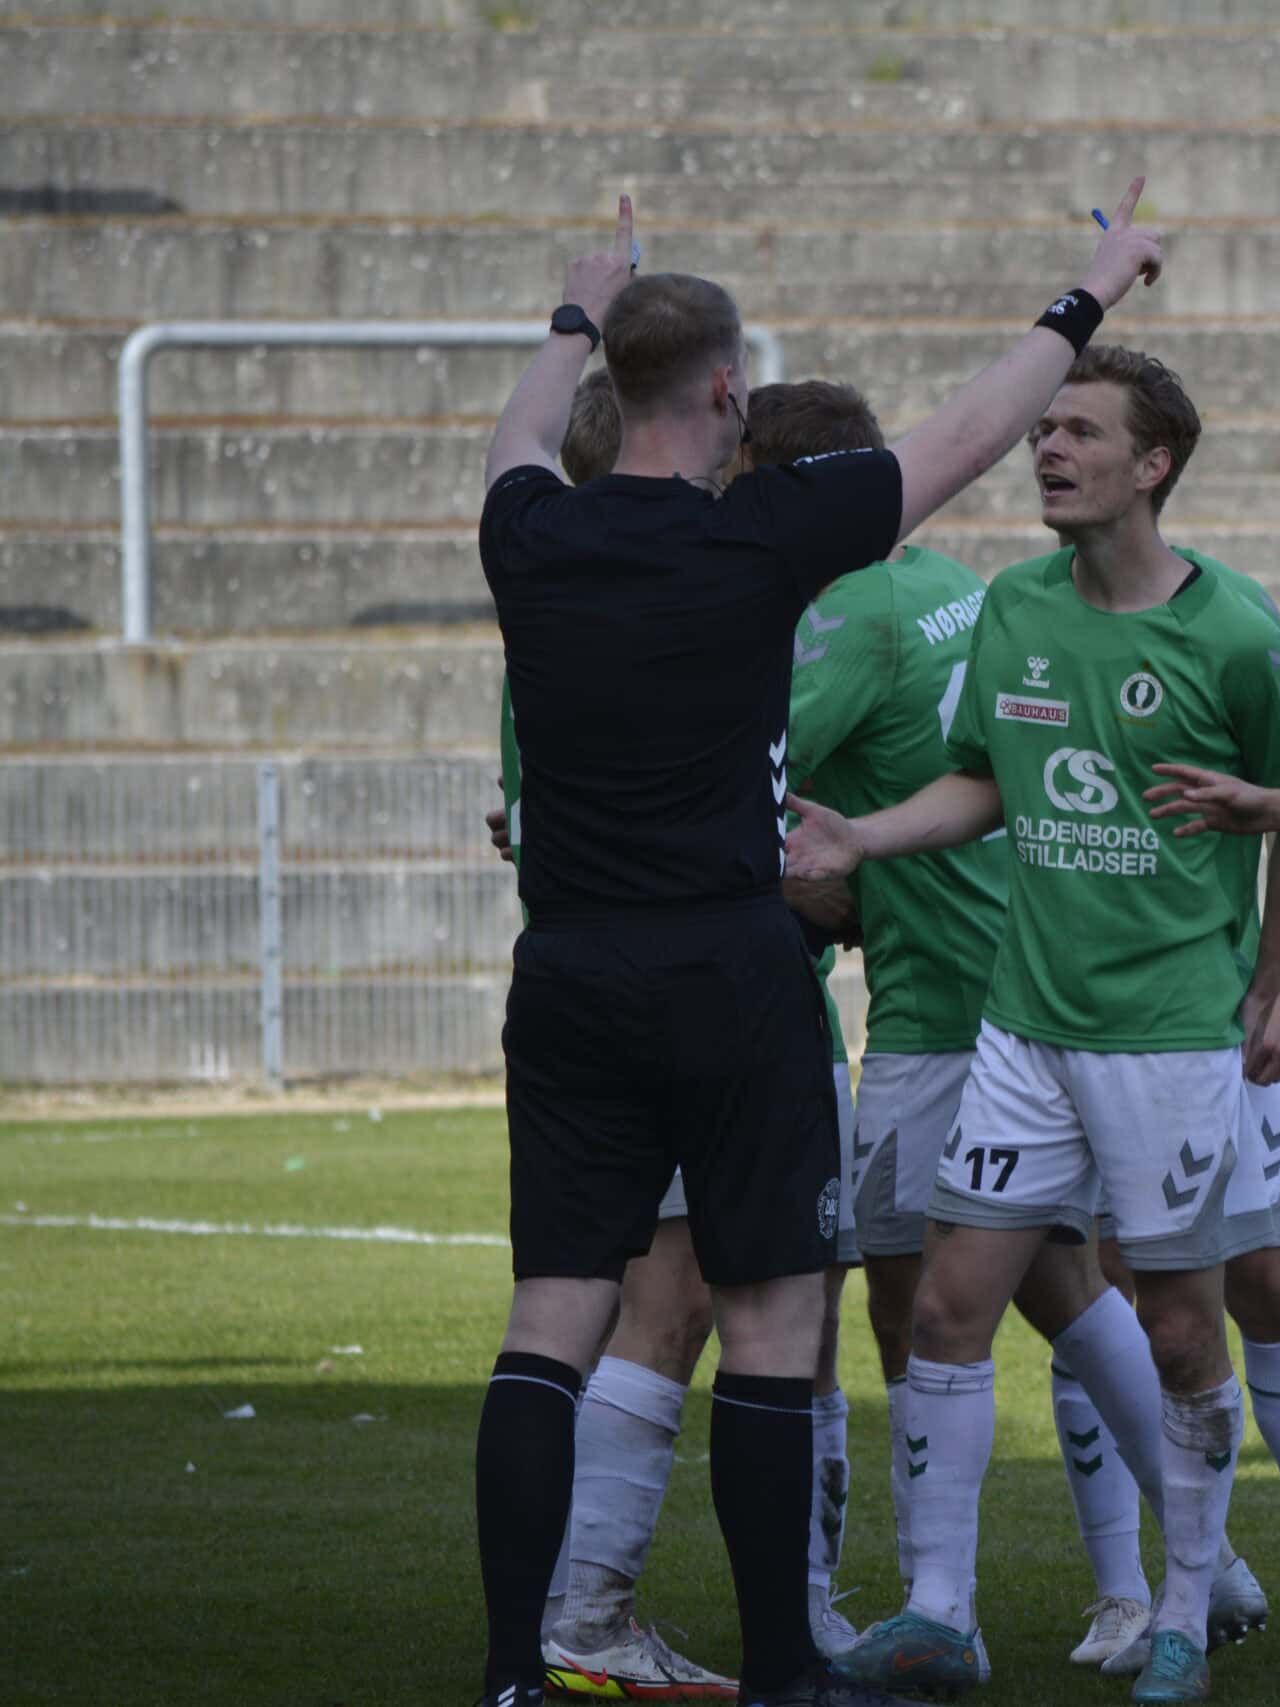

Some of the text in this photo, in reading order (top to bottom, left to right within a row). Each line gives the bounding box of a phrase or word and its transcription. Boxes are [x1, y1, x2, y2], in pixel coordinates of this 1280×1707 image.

[1008, 704, 1066, 720] BAUHAUS
[1015, 815, 1160, 851] OLDENBORG
[1016, 841, 1158, 876] STILLADSER
[964, 1146, 1020, 1193] 17
